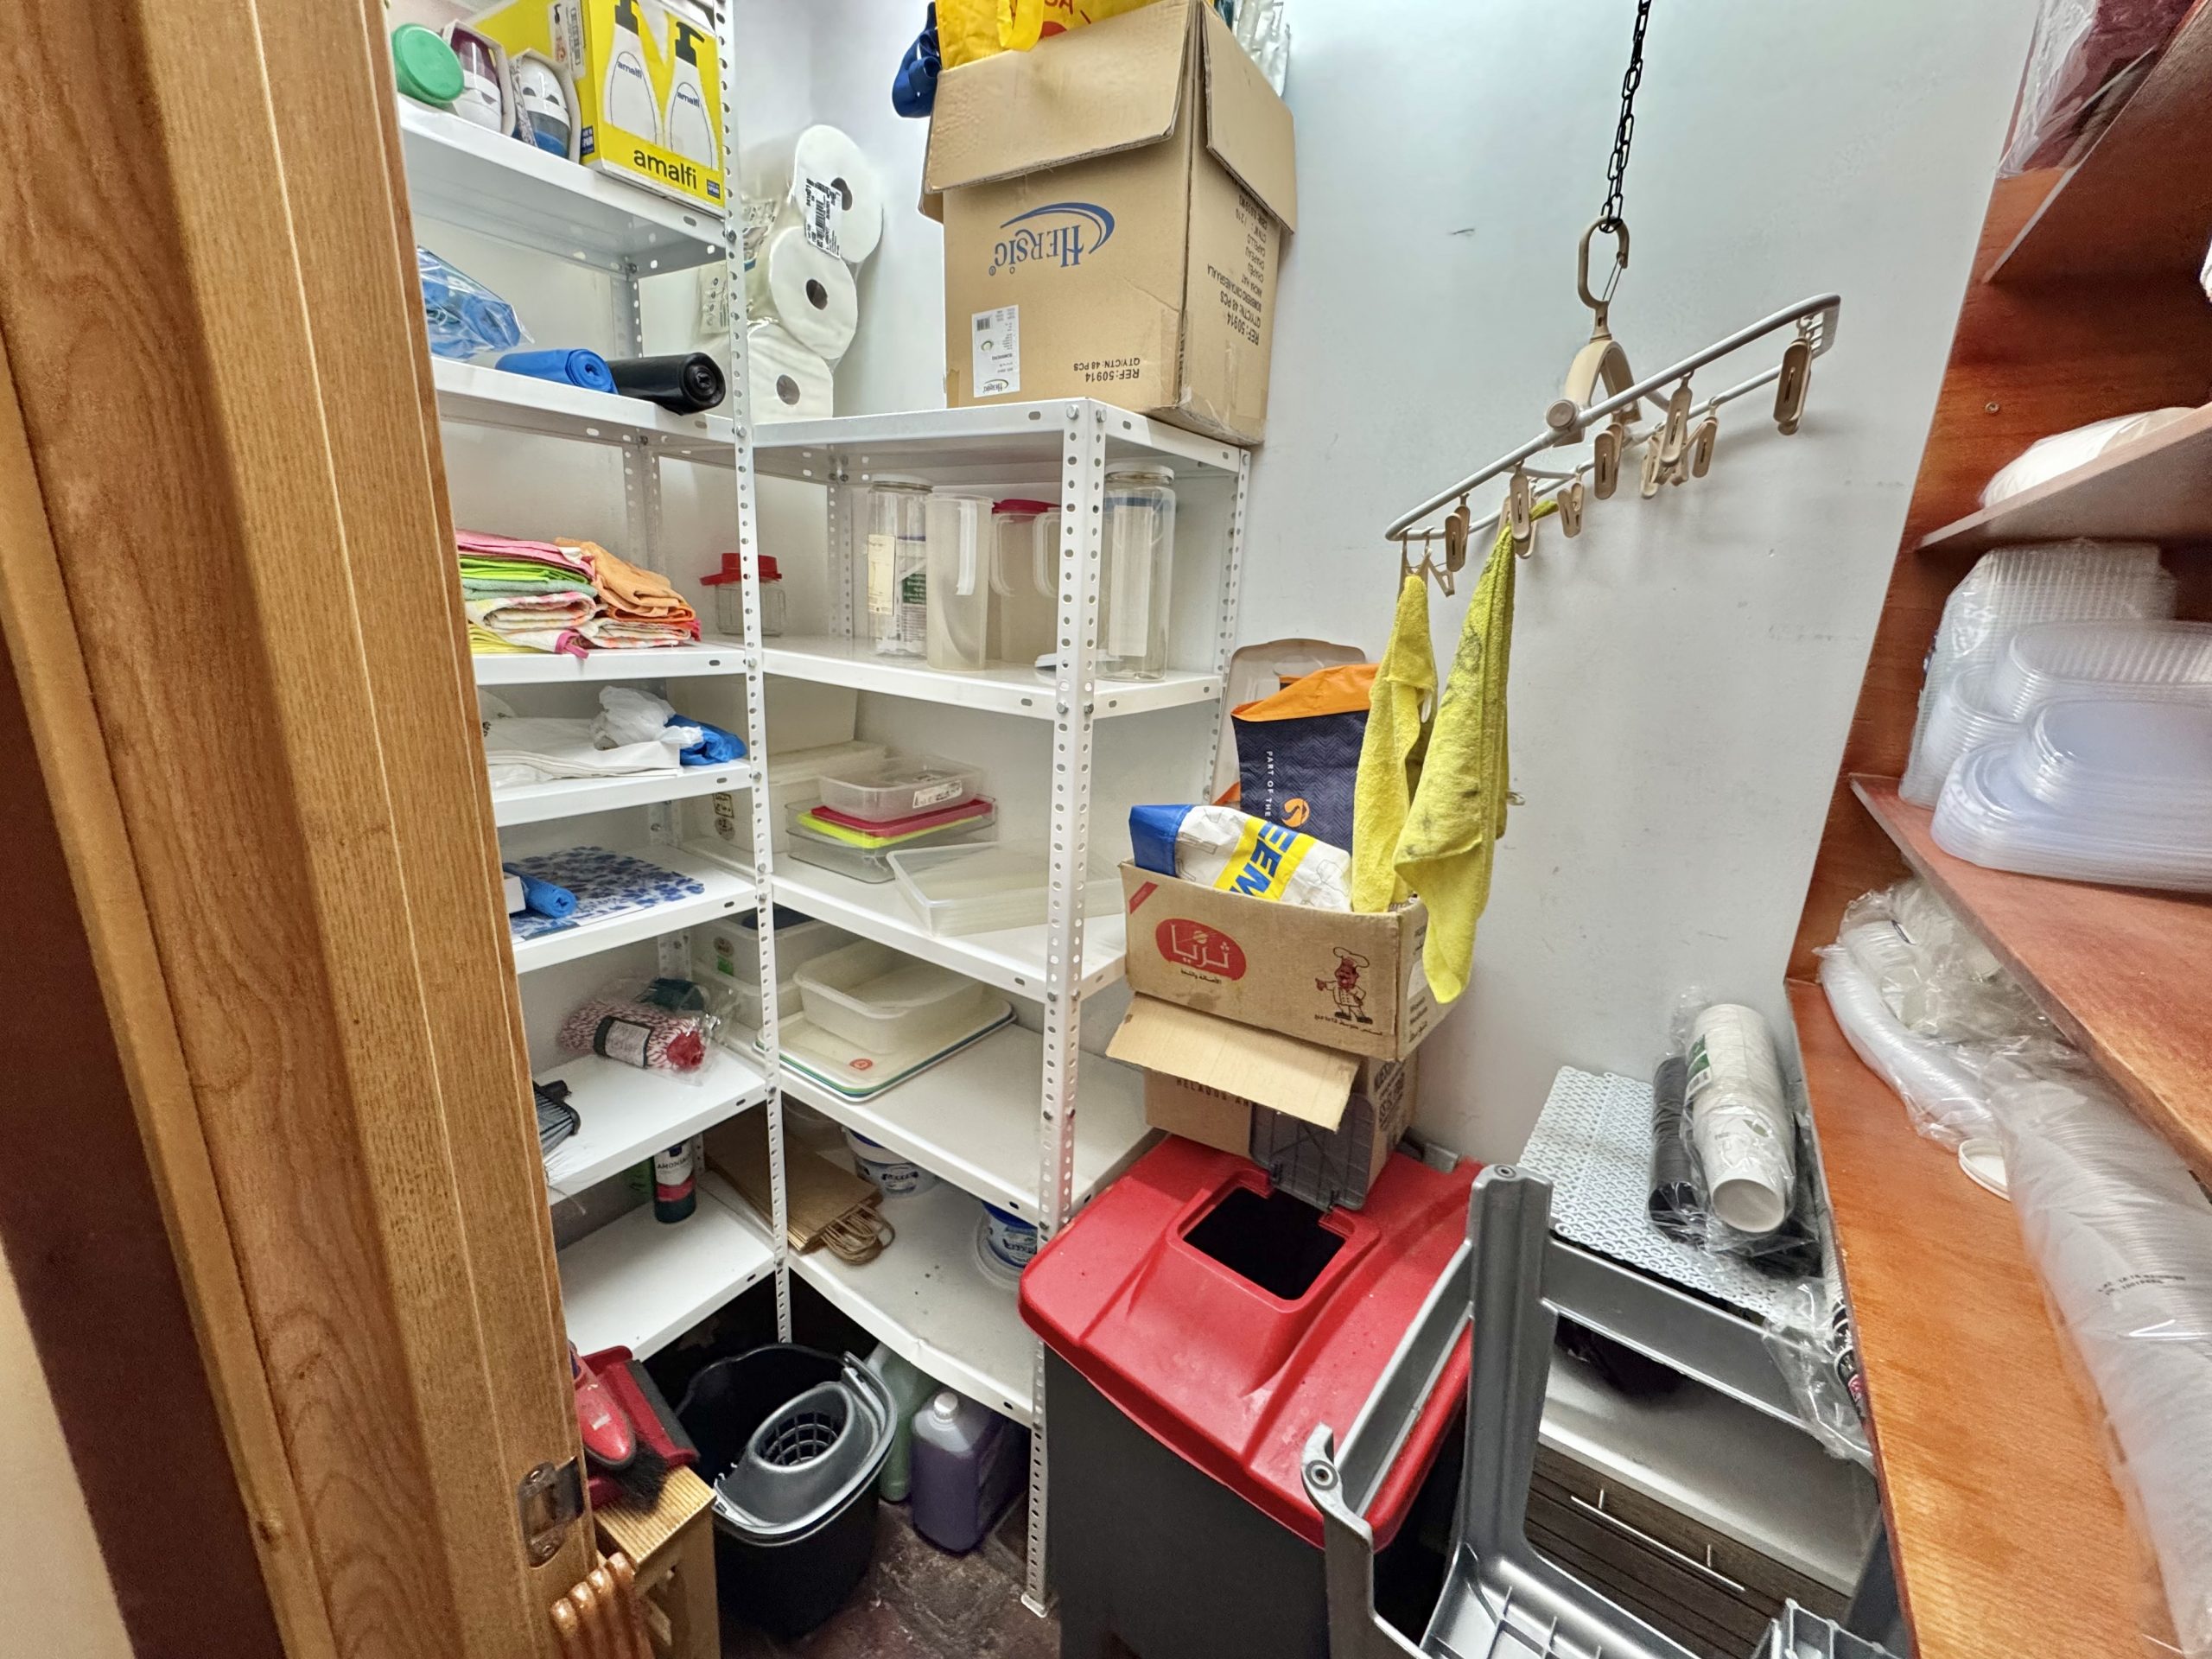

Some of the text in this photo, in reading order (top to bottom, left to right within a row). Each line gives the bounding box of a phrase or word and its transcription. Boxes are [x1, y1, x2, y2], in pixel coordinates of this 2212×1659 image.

[617, 61, 643, 79] amalfi
[677, 92, 700, 108] amalfi
[633, 149, 697, 189] amalfi
[1247, 233, 1265, 257] CAPELLO
[1245, 246, 1264, 270] CHAPEAU
[1220, 290, 1232, 308] PCS
[1231, 299, 1239, 312] 48
[1073, 362, 1090, 372] PCS
[1090, 360, 1101, 370] 48
[1266, 750, 1274, 775] PART
[1266, 780, 1274, 794] OF
